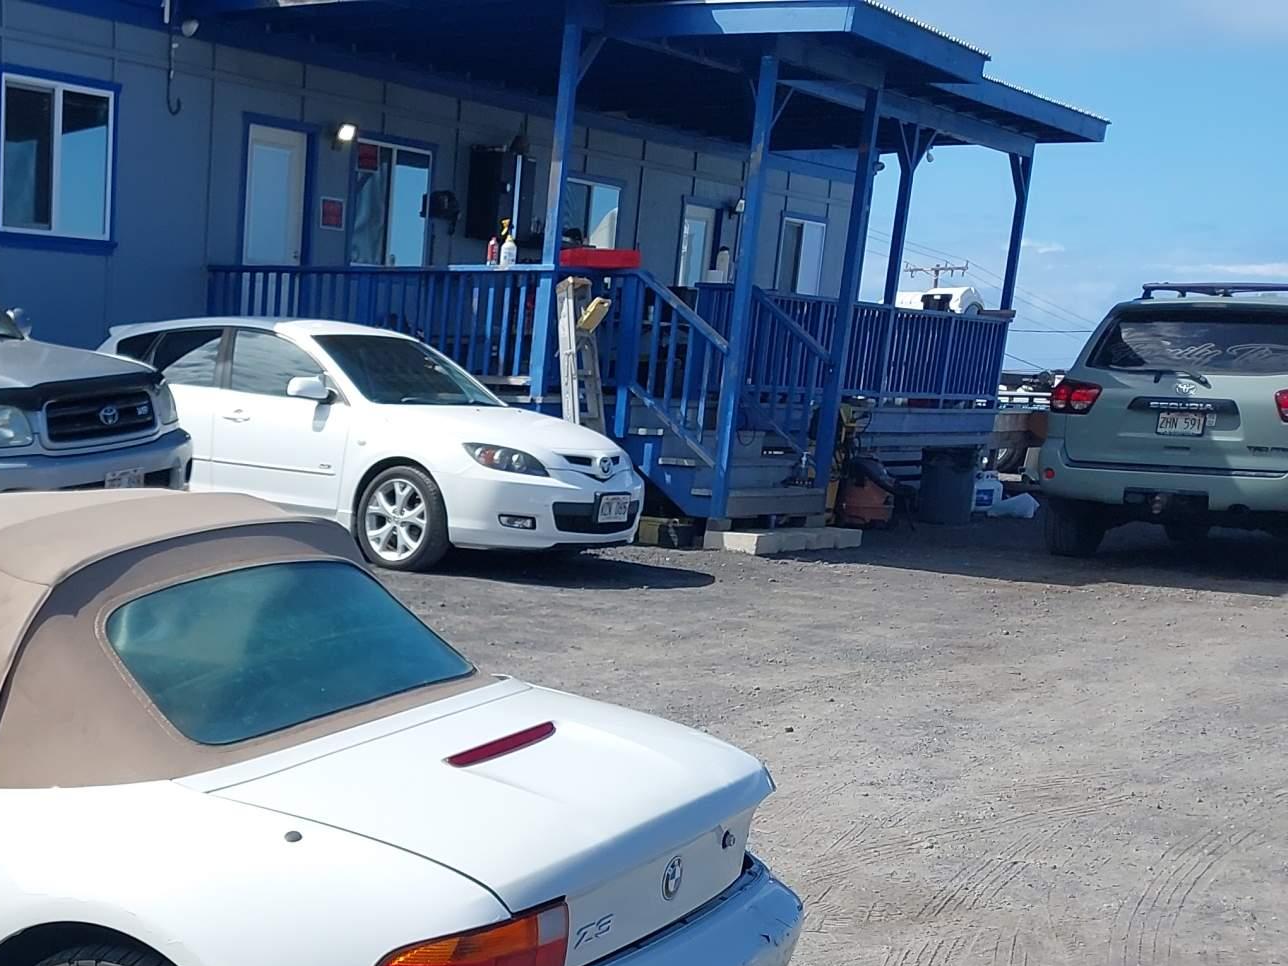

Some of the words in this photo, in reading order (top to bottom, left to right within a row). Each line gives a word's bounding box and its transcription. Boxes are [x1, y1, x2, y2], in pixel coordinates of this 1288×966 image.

[1149, 401, 1214, 410] SEQUOIA
[1159, 416, 1178, 430] ZHN
[1184, 417, 1202, 431] 591
[574, 913, 614, 950] Z3
